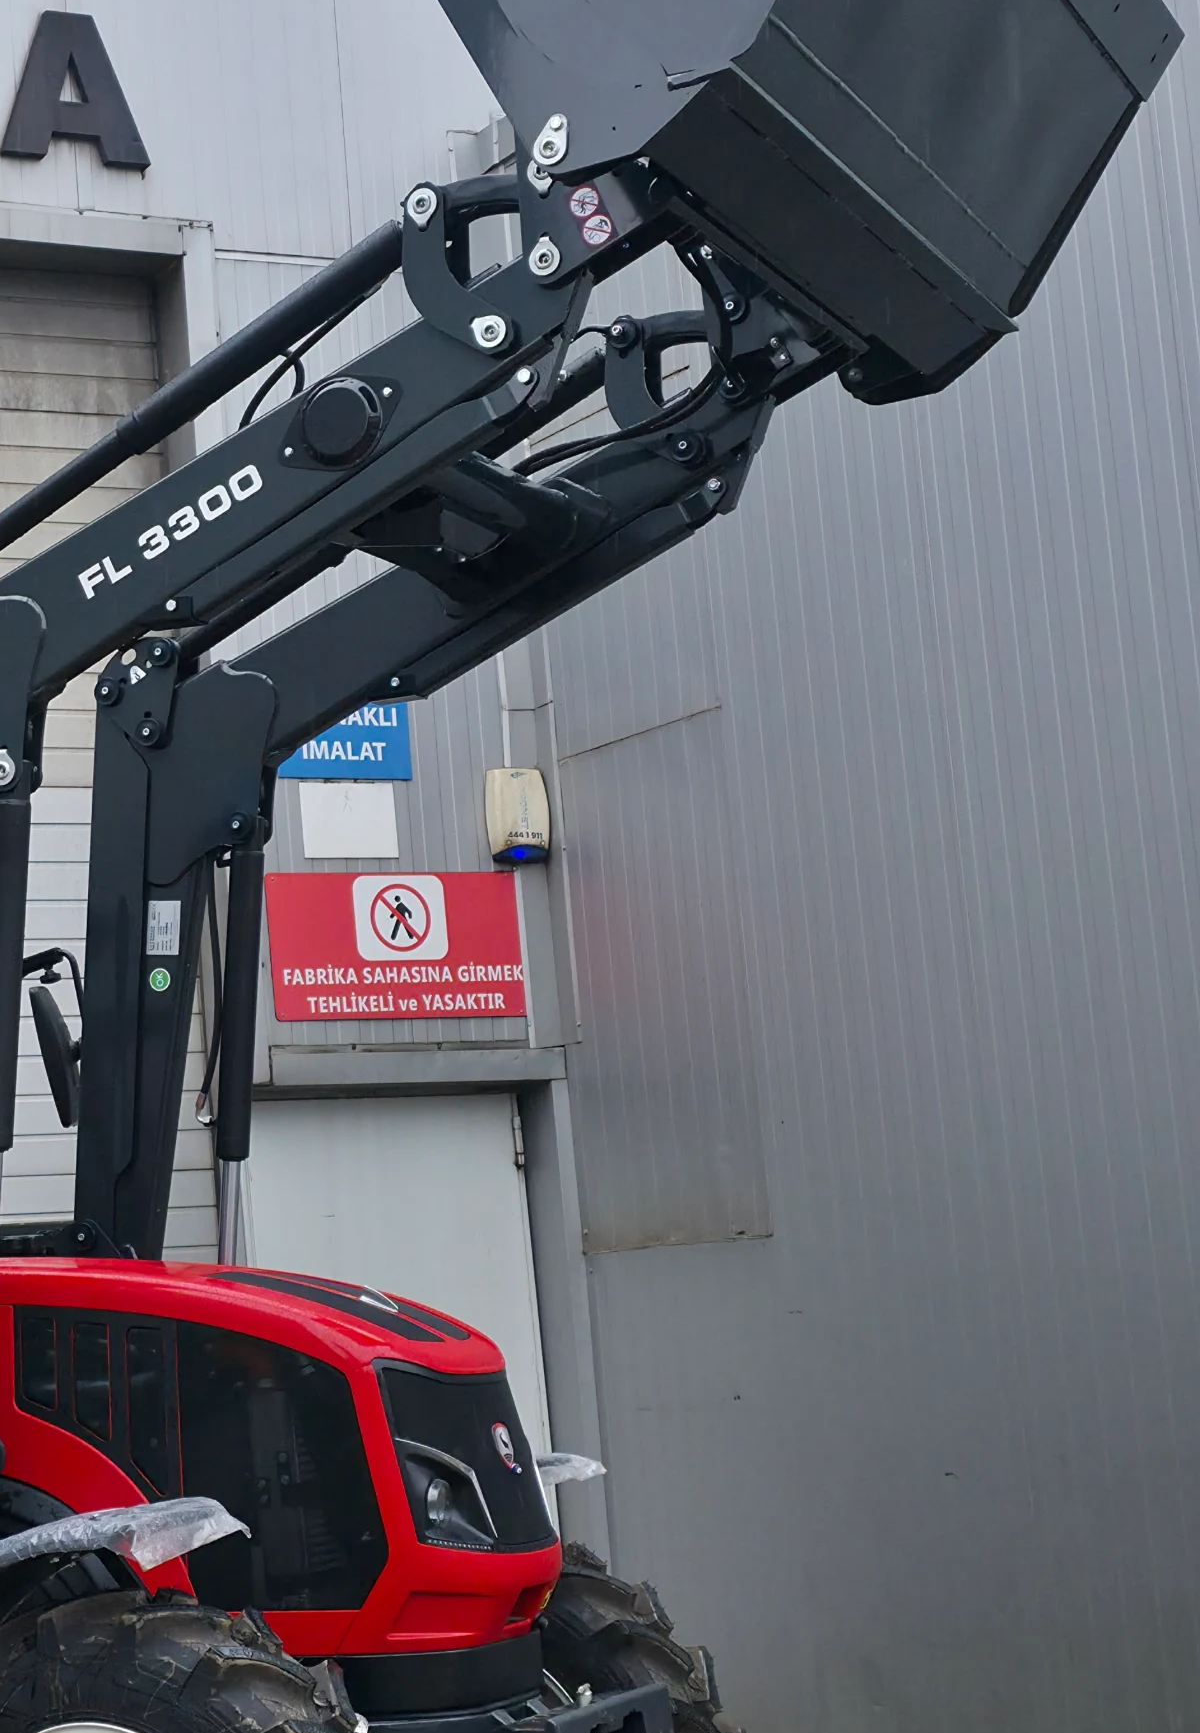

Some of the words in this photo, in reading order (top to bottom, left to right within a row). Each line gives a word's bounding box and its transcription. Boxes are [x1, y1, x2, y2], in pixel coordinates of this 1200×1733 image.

[77, 556, 133, 600] FL
[138, 464, 263, 560] 3300
[155, 971, 164, 987] OK
[283, 964, 358, 986] FABRİKA
[363, 966, 453, 984] SAHASINA
[458, 961, 524, 983] GİRMEK
[307, 991, 394, 1013] TEHLİKELİ
[399, 999, 418, 1011] ve
[422, 993, 506, 1011] YASAKTIR
